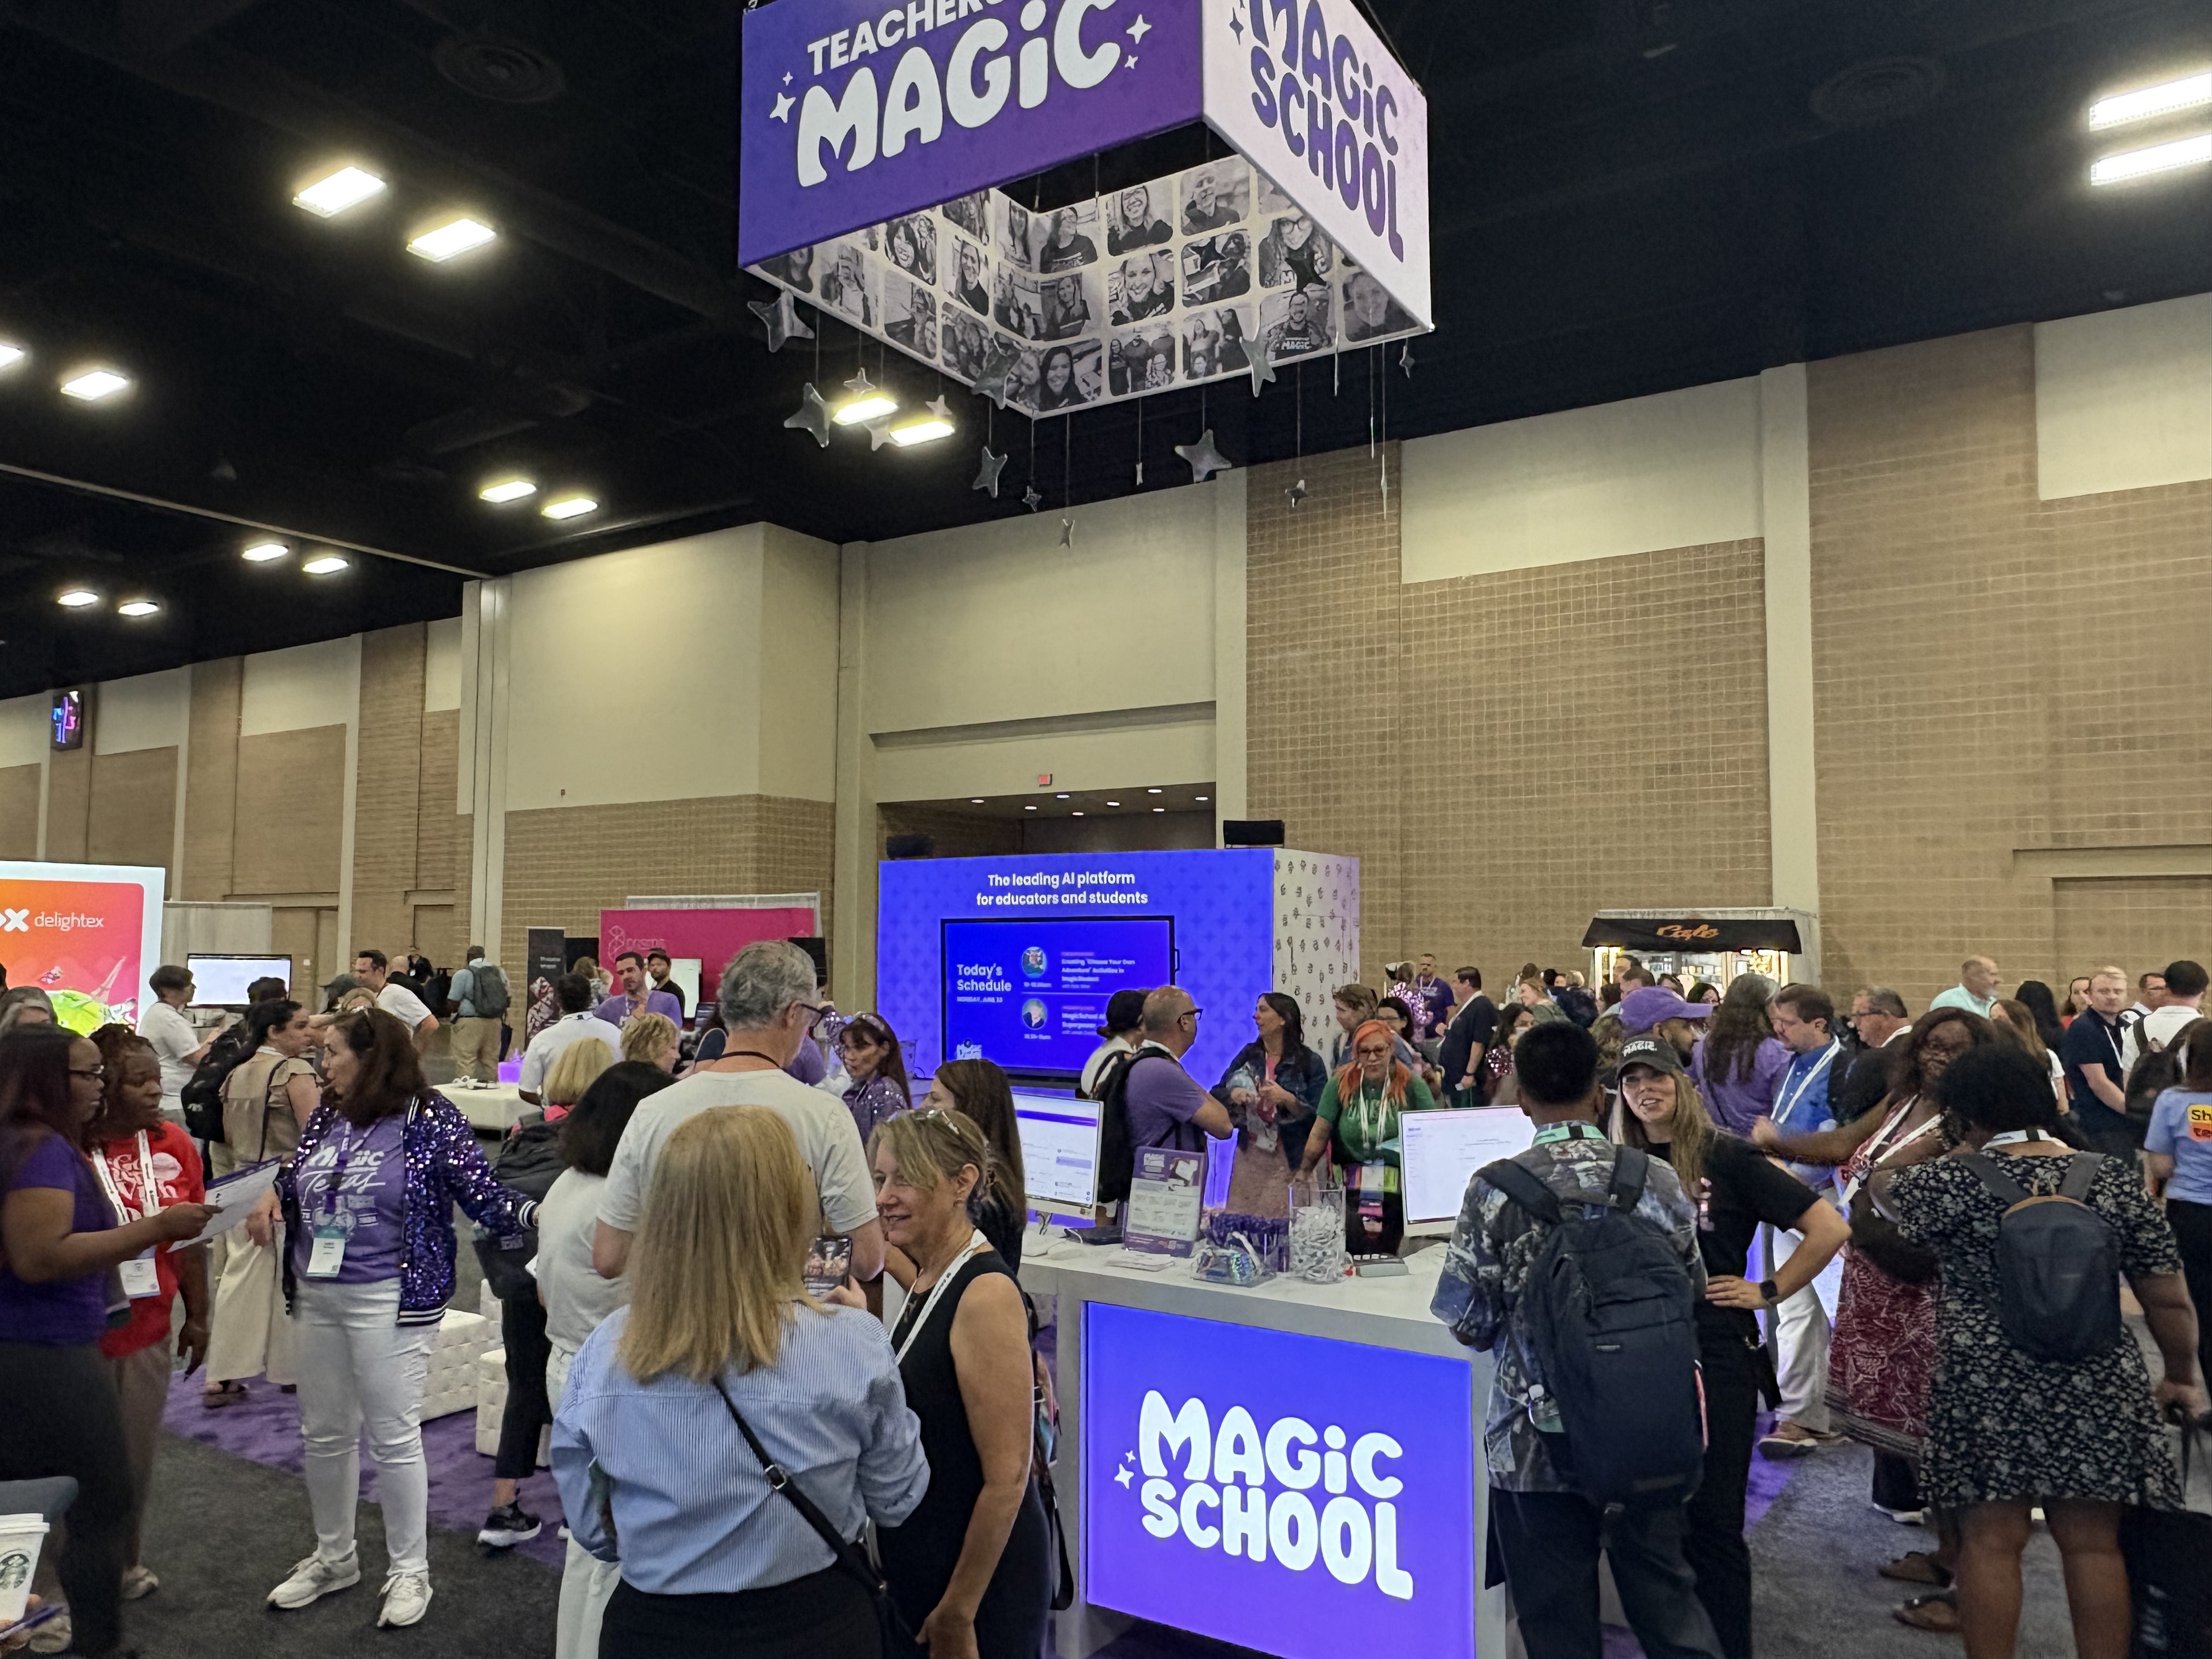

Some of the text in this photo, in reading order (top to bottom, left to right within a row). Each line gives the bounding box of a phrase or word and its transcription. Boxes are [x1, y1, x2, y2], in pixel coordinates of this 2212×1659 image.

[1250, 46, 1404, 263] SCHOOL
[988, 871, 1136, 889] The leading AI platform
[976, 891, 1148, 905] for educators and students
[34, 911, 104, 932] delightex
[956, 963, 1003, 979] Today's
[957, 979, 1012, 992] Schedule
[1141, 1478, 1414, 1600] SCHOOL
